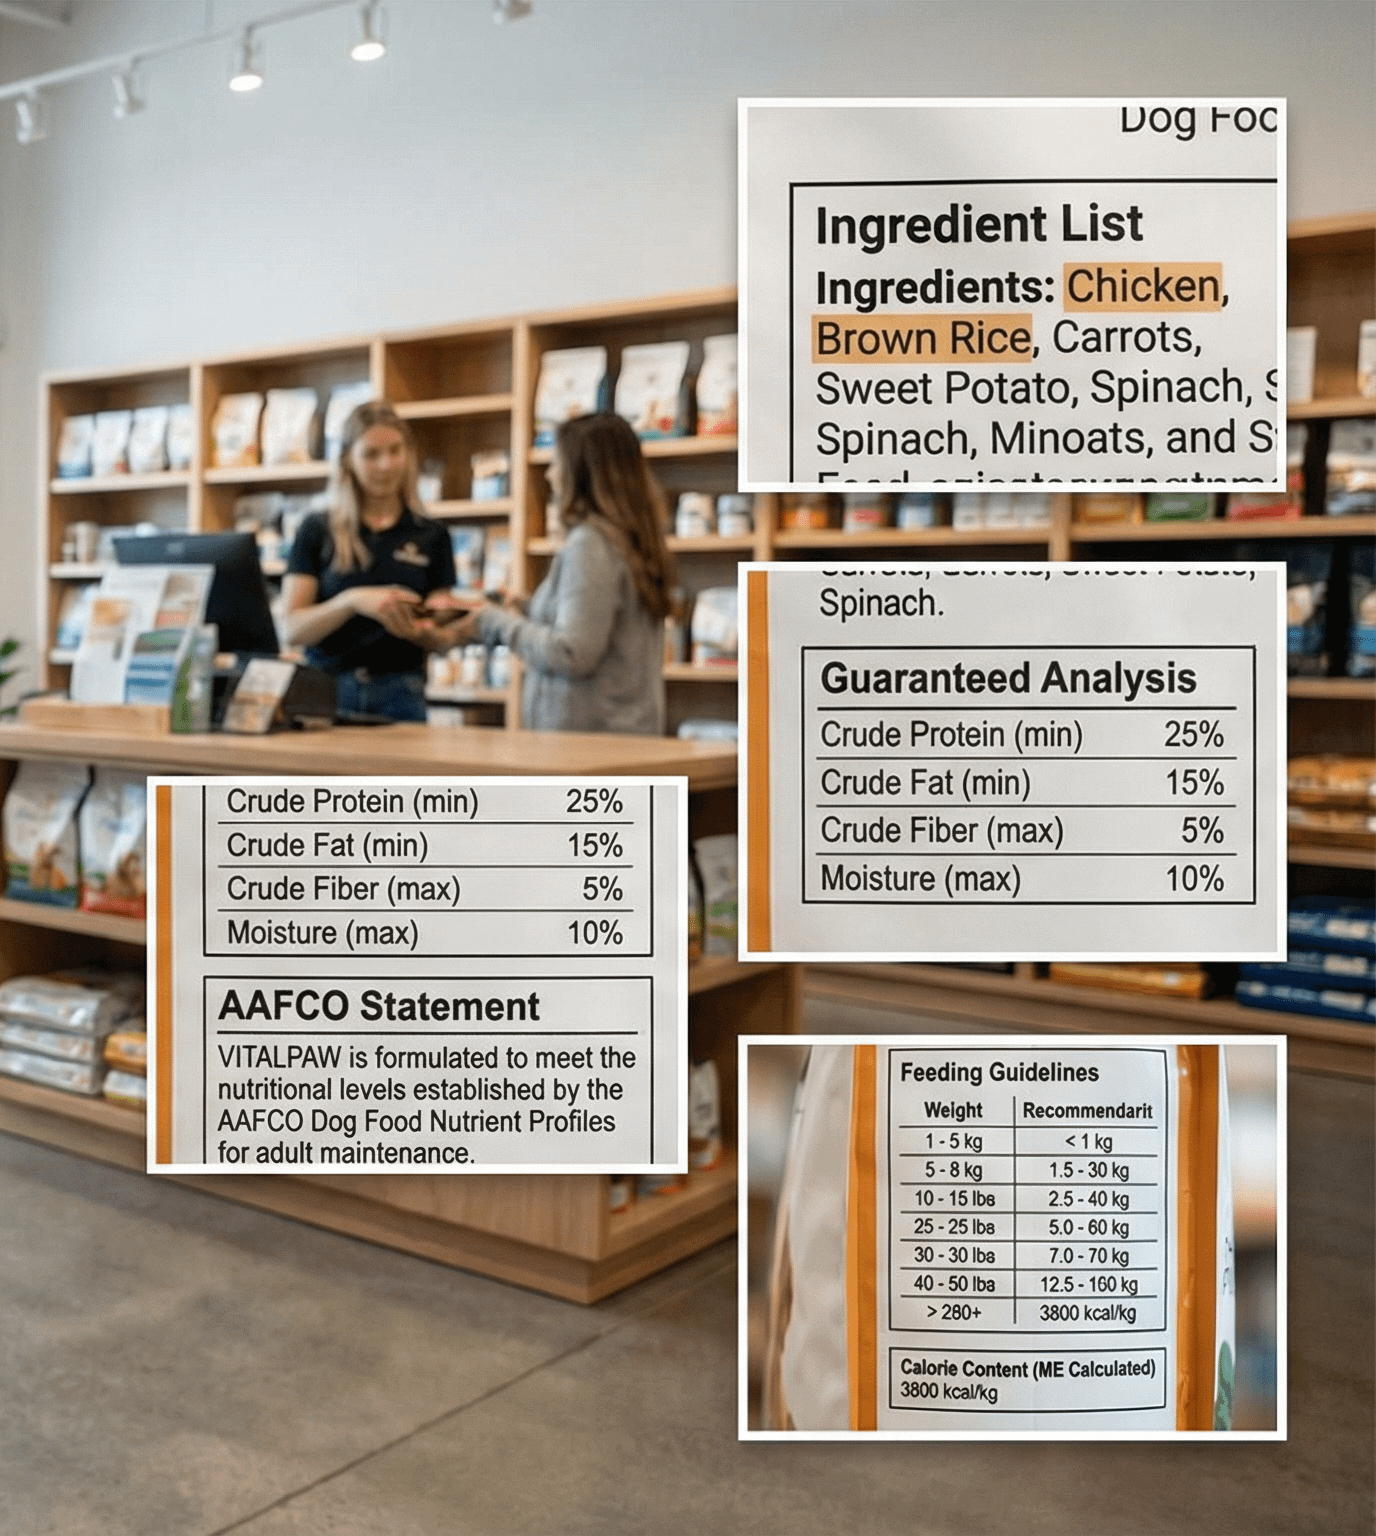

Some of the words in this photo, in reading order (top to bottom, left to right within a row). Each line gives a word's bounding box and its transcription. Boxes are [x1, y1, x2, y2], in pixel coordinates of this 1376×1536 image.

[1121, 107, 1196, 142] Dog
[817, 202, 1048, 255] Ingredient
[1062, 201, 1144, 242] List
[817, 267, 1055, 314] Ingredients:
[1068, 266, 1229, 308] Chicken,
[818, 321, 937, 355] Brown
[951, 319, 1038, 359] Rice,
[1053, 319, 1202, 358] Carrots,
[816, 370, 933, 406] Sweet
[946, 370, 1079, 410] Potato,
[1090, 366, 1253, 413] Spinach,
[816, 419, 978, 464] Spinach,
[991, 420, 1154, 460] Minoats,
[1166, 417, 1236, 454] and
[819, 586, 944, 624] Spinach.
[820, 660, 1031, 695] Guaranteed
[1040, 660, 1197, 703] Analysis
[821, 719, 902, 748] Crude
[910, 719, 1005, 748] Protein
[1014, 719, 1083, 755] (min)
[1164, 719, 1225, 748] 25%
[821, 767, 902, 796] Crude
[911, 768, 954, 796] Fat
[962, 767, 1031, 803] (min)
[1166, 767, 1225, 796] 15%
[227, 787, 306, 814] Crude
[313, 787, 404, 814] Protein
[413, 787, 479, 820] (min)
[566, 787, 624, 814] 25%
[821, 815, 902, 844] Crude
[910, 815, 980, 844] Fiber
[987, 815, 1064, 851] (max)
[1181, 815, 1225, 844] 5%
[227, 831, 305, 858] Crude
[313, 831, 355, 858] Fat
[363, 830, 428, 864] (min)
[568, 831, 624, 858] 15%
[227, 874, 306, 901] Crude
[314, 875, 380, 901] Fiber
[387, 874, 461, 908] (max)
[582, 875, 624, 902] 5%
[821, 863, 936, 892] Moisture
[944, 863, 1021, 899] (max)
[1166, 863, 1225, 892] 10%
[227, 918, 338, 945] Moisture
[345, 918, 419, 952] (max)
[568, 918, 624, 946] 10%
[217, 989, 350, 1022] AAFCO
[360, 989, 541, 1022] Statement
[217, 1044, 343, 1069] VITALPAW
[349, 1045, 368, 1069] is
[374, 1044, 498, 1070] formulated
[505, 1046, 529, 1070] to
[535, 1046, 594, 1069] meet
[599, 1045, 637, 1069] the
[900, 1061, 983, 1087] Feeding
[989, 1061, 1100, 1083] Guidelines
[218, 1076, 332, 1101] nutritional
[340, 1077, 407, 1101] levels
[413, 1077, 545, 1101] established
[553, 1077, 581, 1107] by
[586, 1077, 624, 1101] the
[216, 1108, 304, 1133] AAFCO
[311, 1108, 357, 1139] Dog
[365, 1108, 422, 1133] Food
[430, 1108, 522, 1133] Nutrient
[529, 1108, 616, 1133] Profiles
[923, 1100, 984, 1122] Weight
[217, 1139, 251, 1164] for
[255, 1140, 314, 1164] adult
[320, 1140, 475, 1164] maintenance.
[925, 1132, 933, 1150] 1
[949, 1132, 960, 1150] 5
[964, 1132, 983, 1153] kg
[1065, 1134, 1076, 1147] <
[1081, 1132, 1089, 1150] 1
[1094, 1132, 1113, 1154] kg
[925, 1160, 936, 1179] 5
[949, 1160, 961, 1178] 8
[964, 1161, 983, 1182] kg
[1049, 1160, 1074, 1179] 1.5
[1087, 1160, 1108, 1179] 30
[1111, 1161, 1130, 1182] kg
[915, 1189, 935, 1207] 10
[949, 1189, 969, 1207] 15
[1048, 1189, 1074, 1208] 2.5
[1087, 1189, 1108, 1208] 40
[1111, 1190, 1130, 1211] kg
[913, 1217, 935, 1235] 25
[948, 1217, 969, 1235] 25
[1048, 1218, 1074, 1236] 5.0
[1087, 1218, 1108, 1236] 60
[1111, 1218, 1130, 1239] kg
[914, 1245, 935, 1263] 30
[948, 1246, 969, 1264] 30
[1049, 1246, 1074, 1264] 7.0
[1088, 1246, 1108, 1264] 70
[1111, 1246, 1130, 1267] kg
[913, 1274, 934, 1292] 40
[948, 1274, 969, 1292] 50
[1040, 1275, 1075, 1293] 12.5
[1089, 1275, 1118, 1293] 160
[1120, 1275, 1139, 1296] kg
[927, 1305, 938, 1318] >
[941, 1303, 982, 1321] 280+
[1039, 1304, 1080, 1322] 3800
[1083, 1303, 1137, 1325] kcal/kg
[900, 1357, 959, 1377] Calorie
[961, 1359, 1029, 1379] Content
[1032, 1360, 1065, 1382] (ME
[1068, 1358, 1156, 1380] Calculated)
[900, 1380, 939, 1399] 3800
[943, 1382, 998, 1405] kcal/kg
